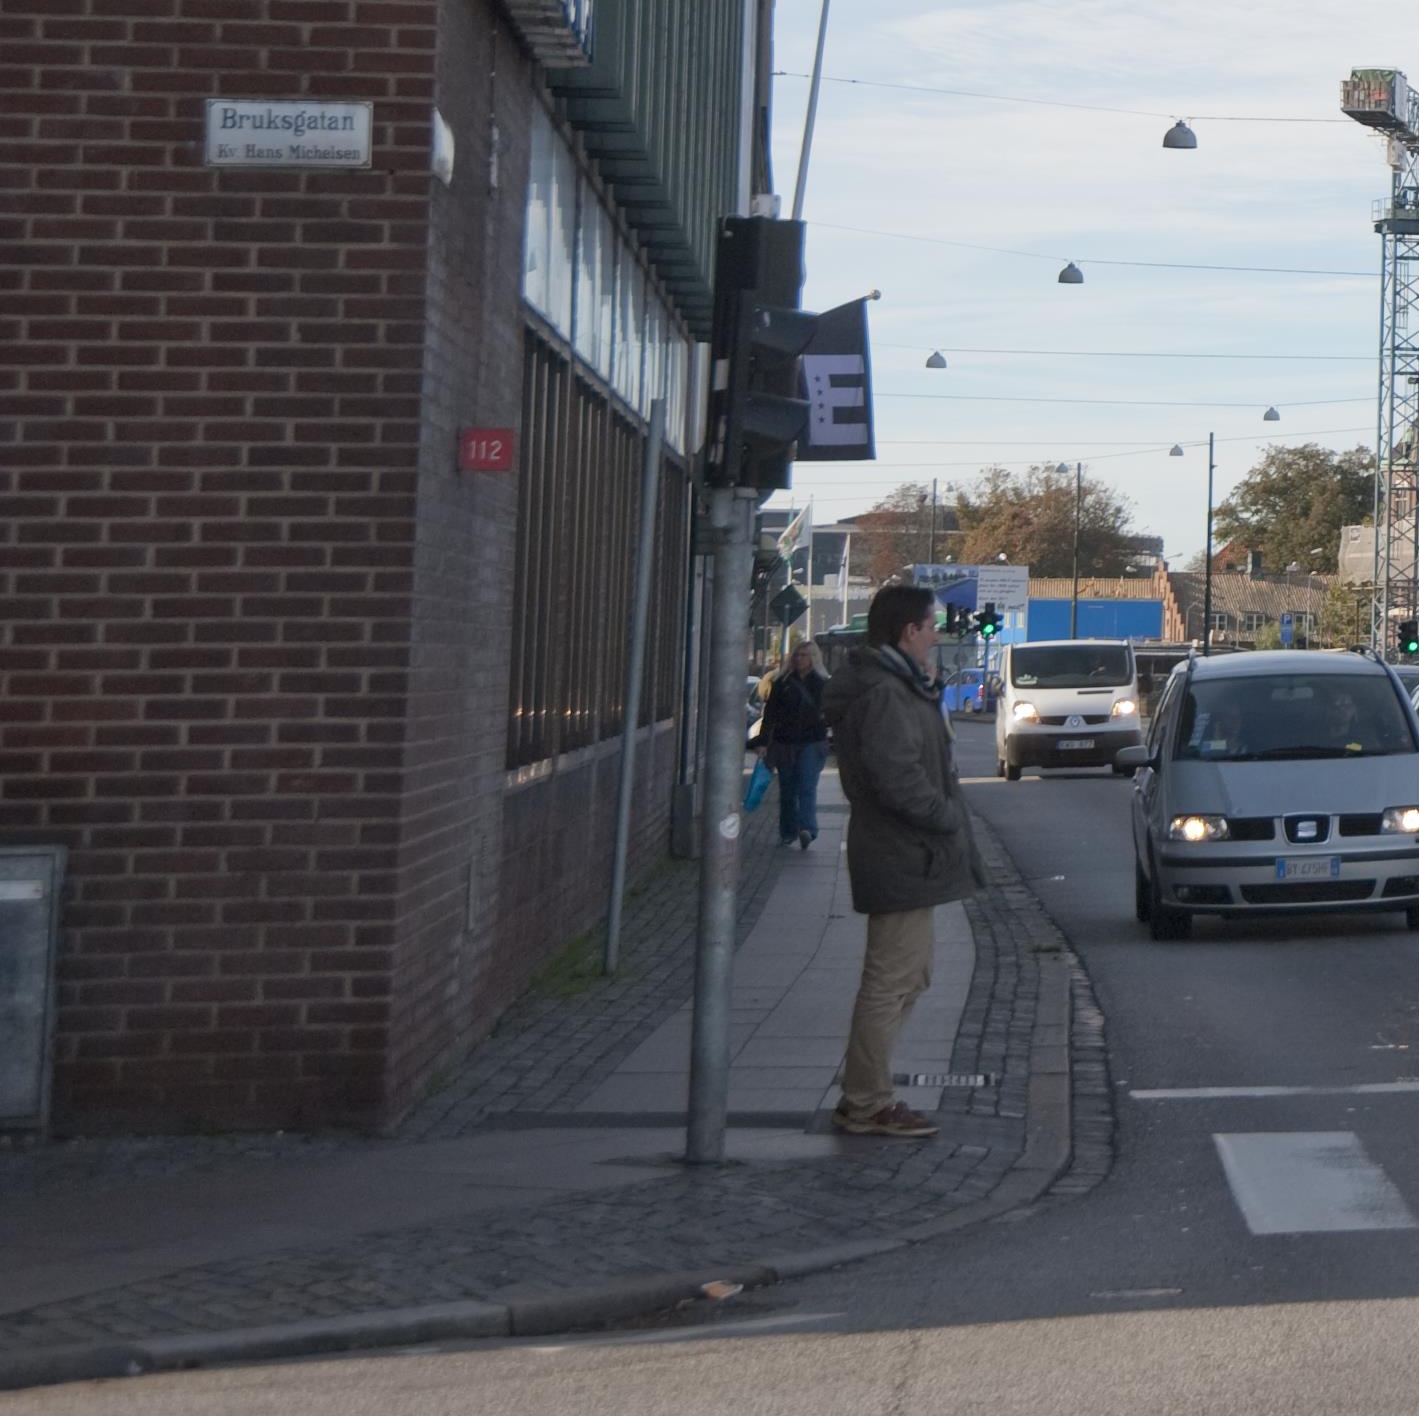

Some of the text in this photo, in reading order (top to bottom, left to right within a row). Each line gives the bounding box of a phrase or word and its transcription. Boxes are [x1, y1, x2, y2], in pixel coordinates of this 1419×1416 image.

[220, 107, 356, 137] Bruksgatan
[245, 143, 283, 160] Hans
[288, 144, 361, 161] Michelsen
[470, 439, 503, 460] 112
